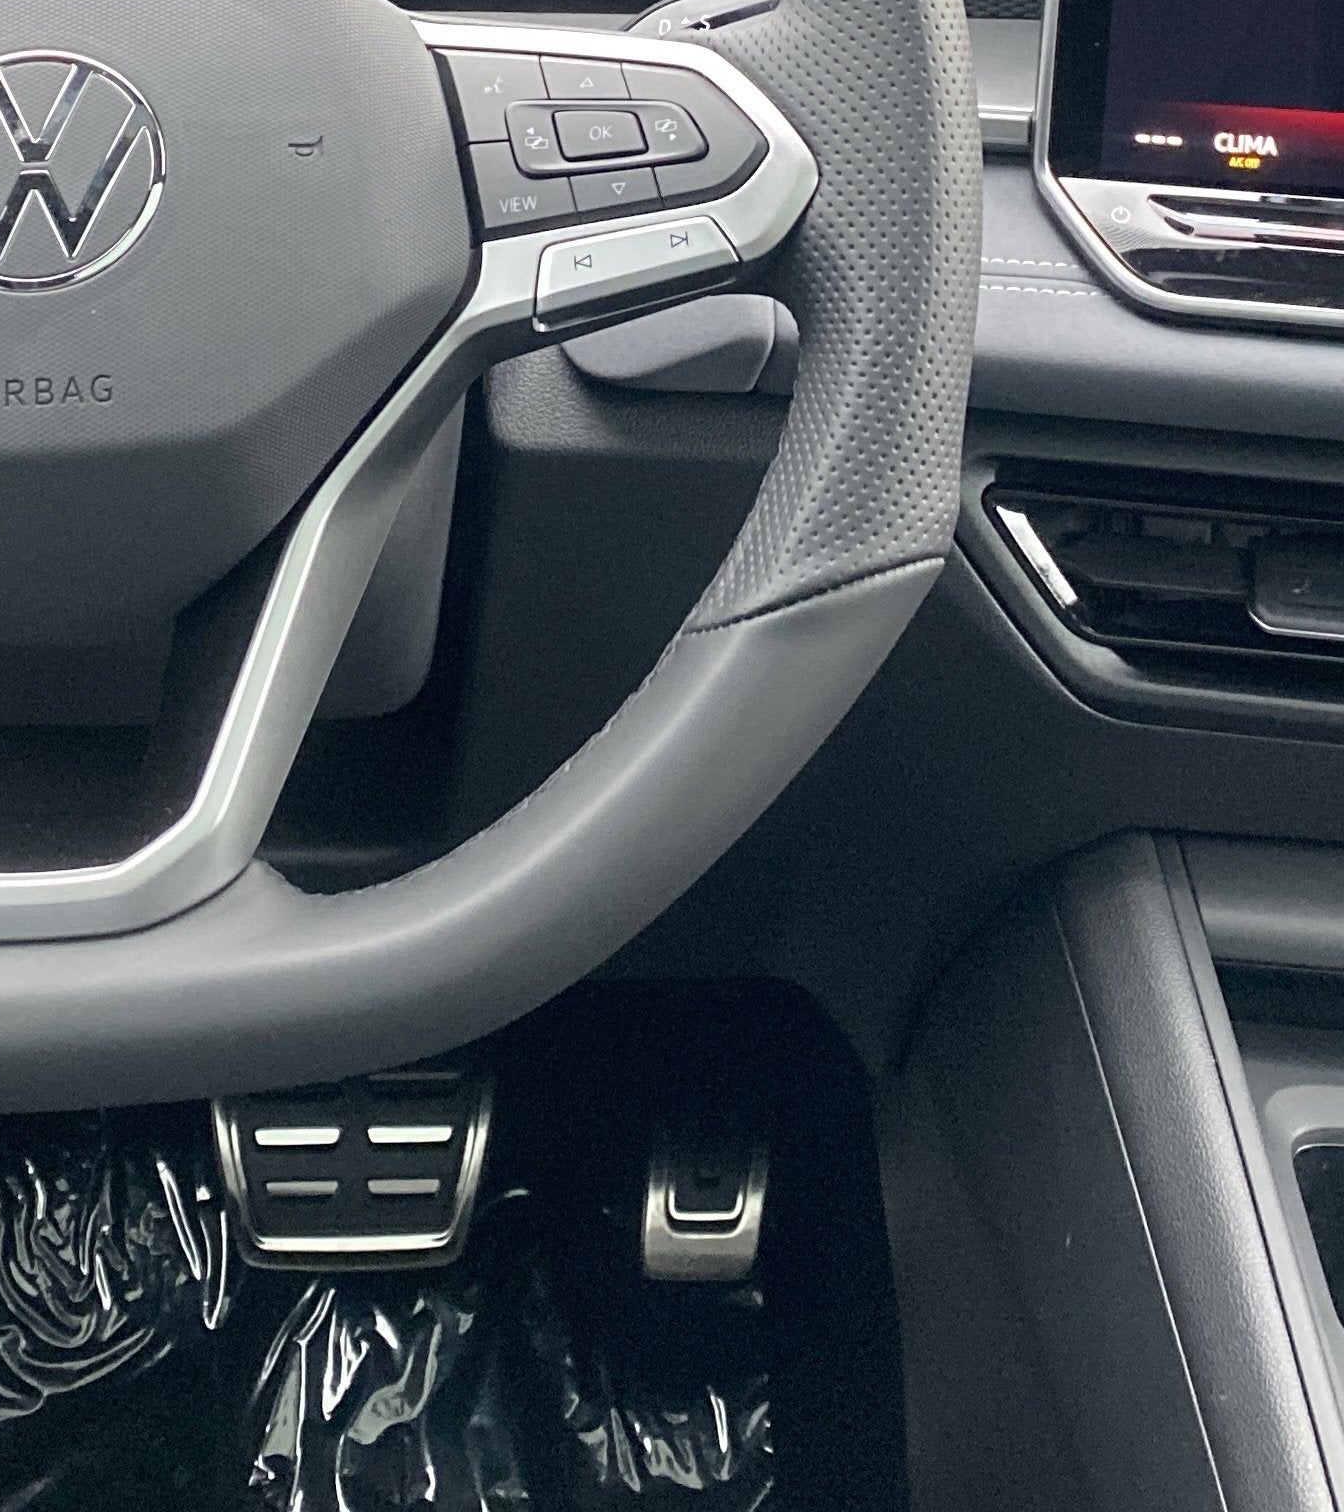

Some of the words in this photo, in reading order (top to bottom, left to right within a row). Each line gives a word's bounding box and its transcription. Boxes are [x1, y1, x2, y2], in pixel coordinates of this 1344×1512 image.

[588, 124, 613, 141] OK
[1213, 132, 1278, 157] CLIMA
[499, 195, 537, 213] VIEW
